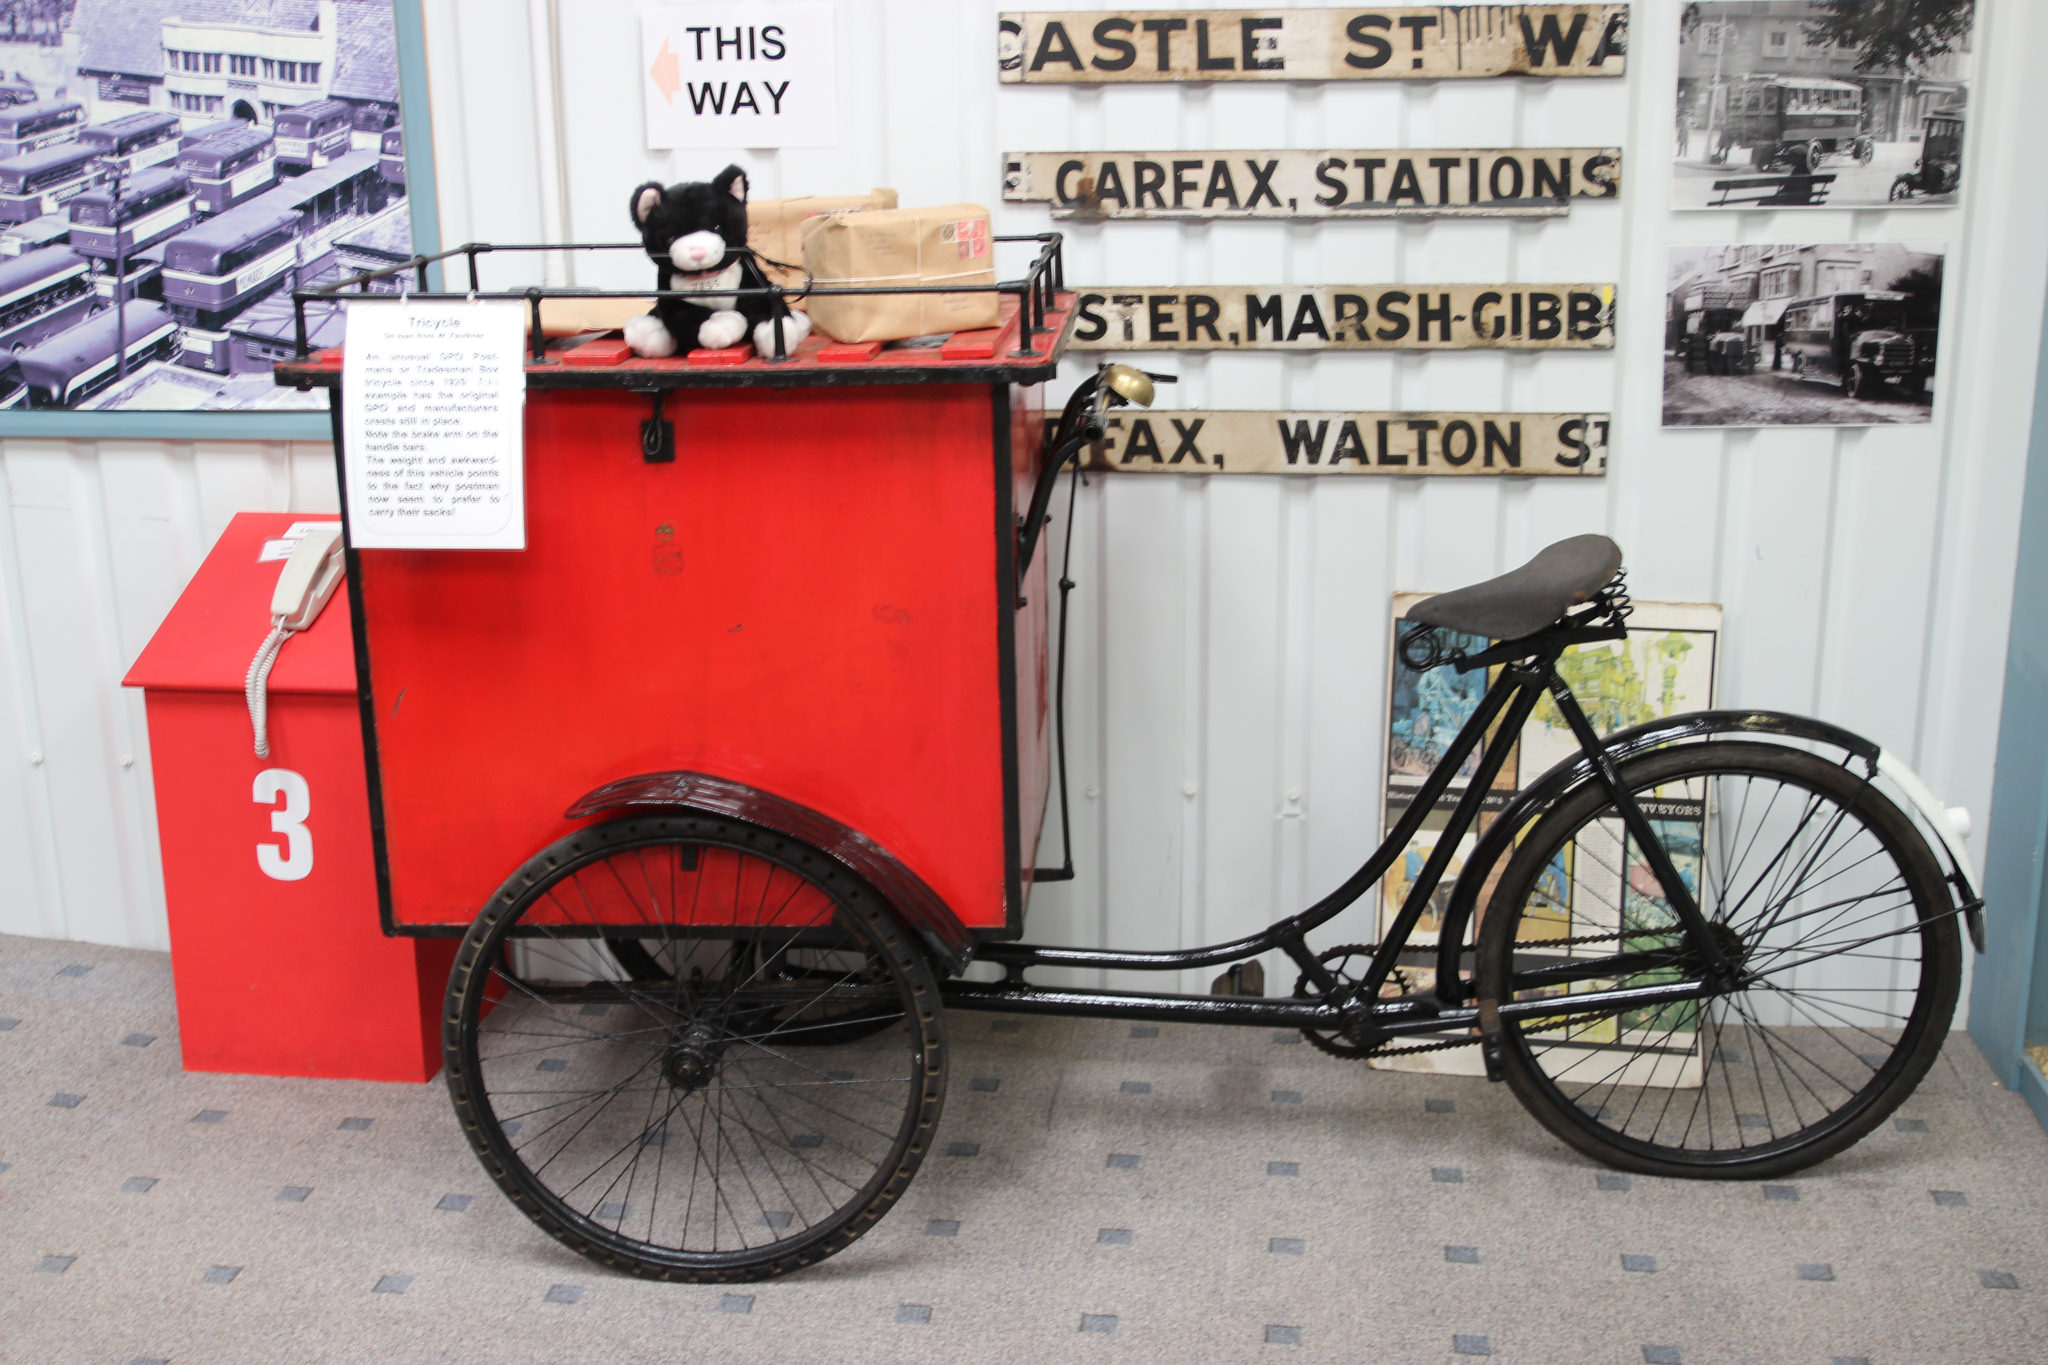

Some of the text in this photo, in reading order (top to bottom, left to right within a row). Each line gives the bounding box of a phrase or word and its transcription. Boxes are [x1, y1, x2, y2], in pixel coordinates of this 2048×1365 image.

[686, 26, 786, 61] THIS
[1000, 18, 1284, 71] CASTLE
[687, 81, 790, 116] WAY
[1056, 155, 1617, 212] CARFAX, STATIONS
[408, 317, 462, 330] Tricycle
[365, 352, 380, 361] An
[389, 352, 431, 361] unusual
[409, 378, 435, 388] circa
[364, 391, 499, 402] example has the original
[396, 404, 416, 414] and
[424, 404, 499, 414] manufacturers
[399, 417, 417, 428] still
[421, 417, 430, 428] in
[364, 430, 499, 439] Note the brake arm on the
[364, 443, 399, 452] handle
[1277, 419, 1522, 467] WALTON
[366, 456, 385, 467] The
[389, 456, 423, 467] weight
[427, 456, 447, 467] and
[366, 468, 500, 479] ness of this vehicle points
[366, 481, 378, 492] to
[382, 481, 400, 492] the
[403, 481, 424, 492] fact
[428, 481, 450, 492] why
[367, 494, 501, 504] now seem to prefer to
[368, 507, 394, 519] carry
[397, 507, 421, 519] their
[252, 768, 314, 881] 3
